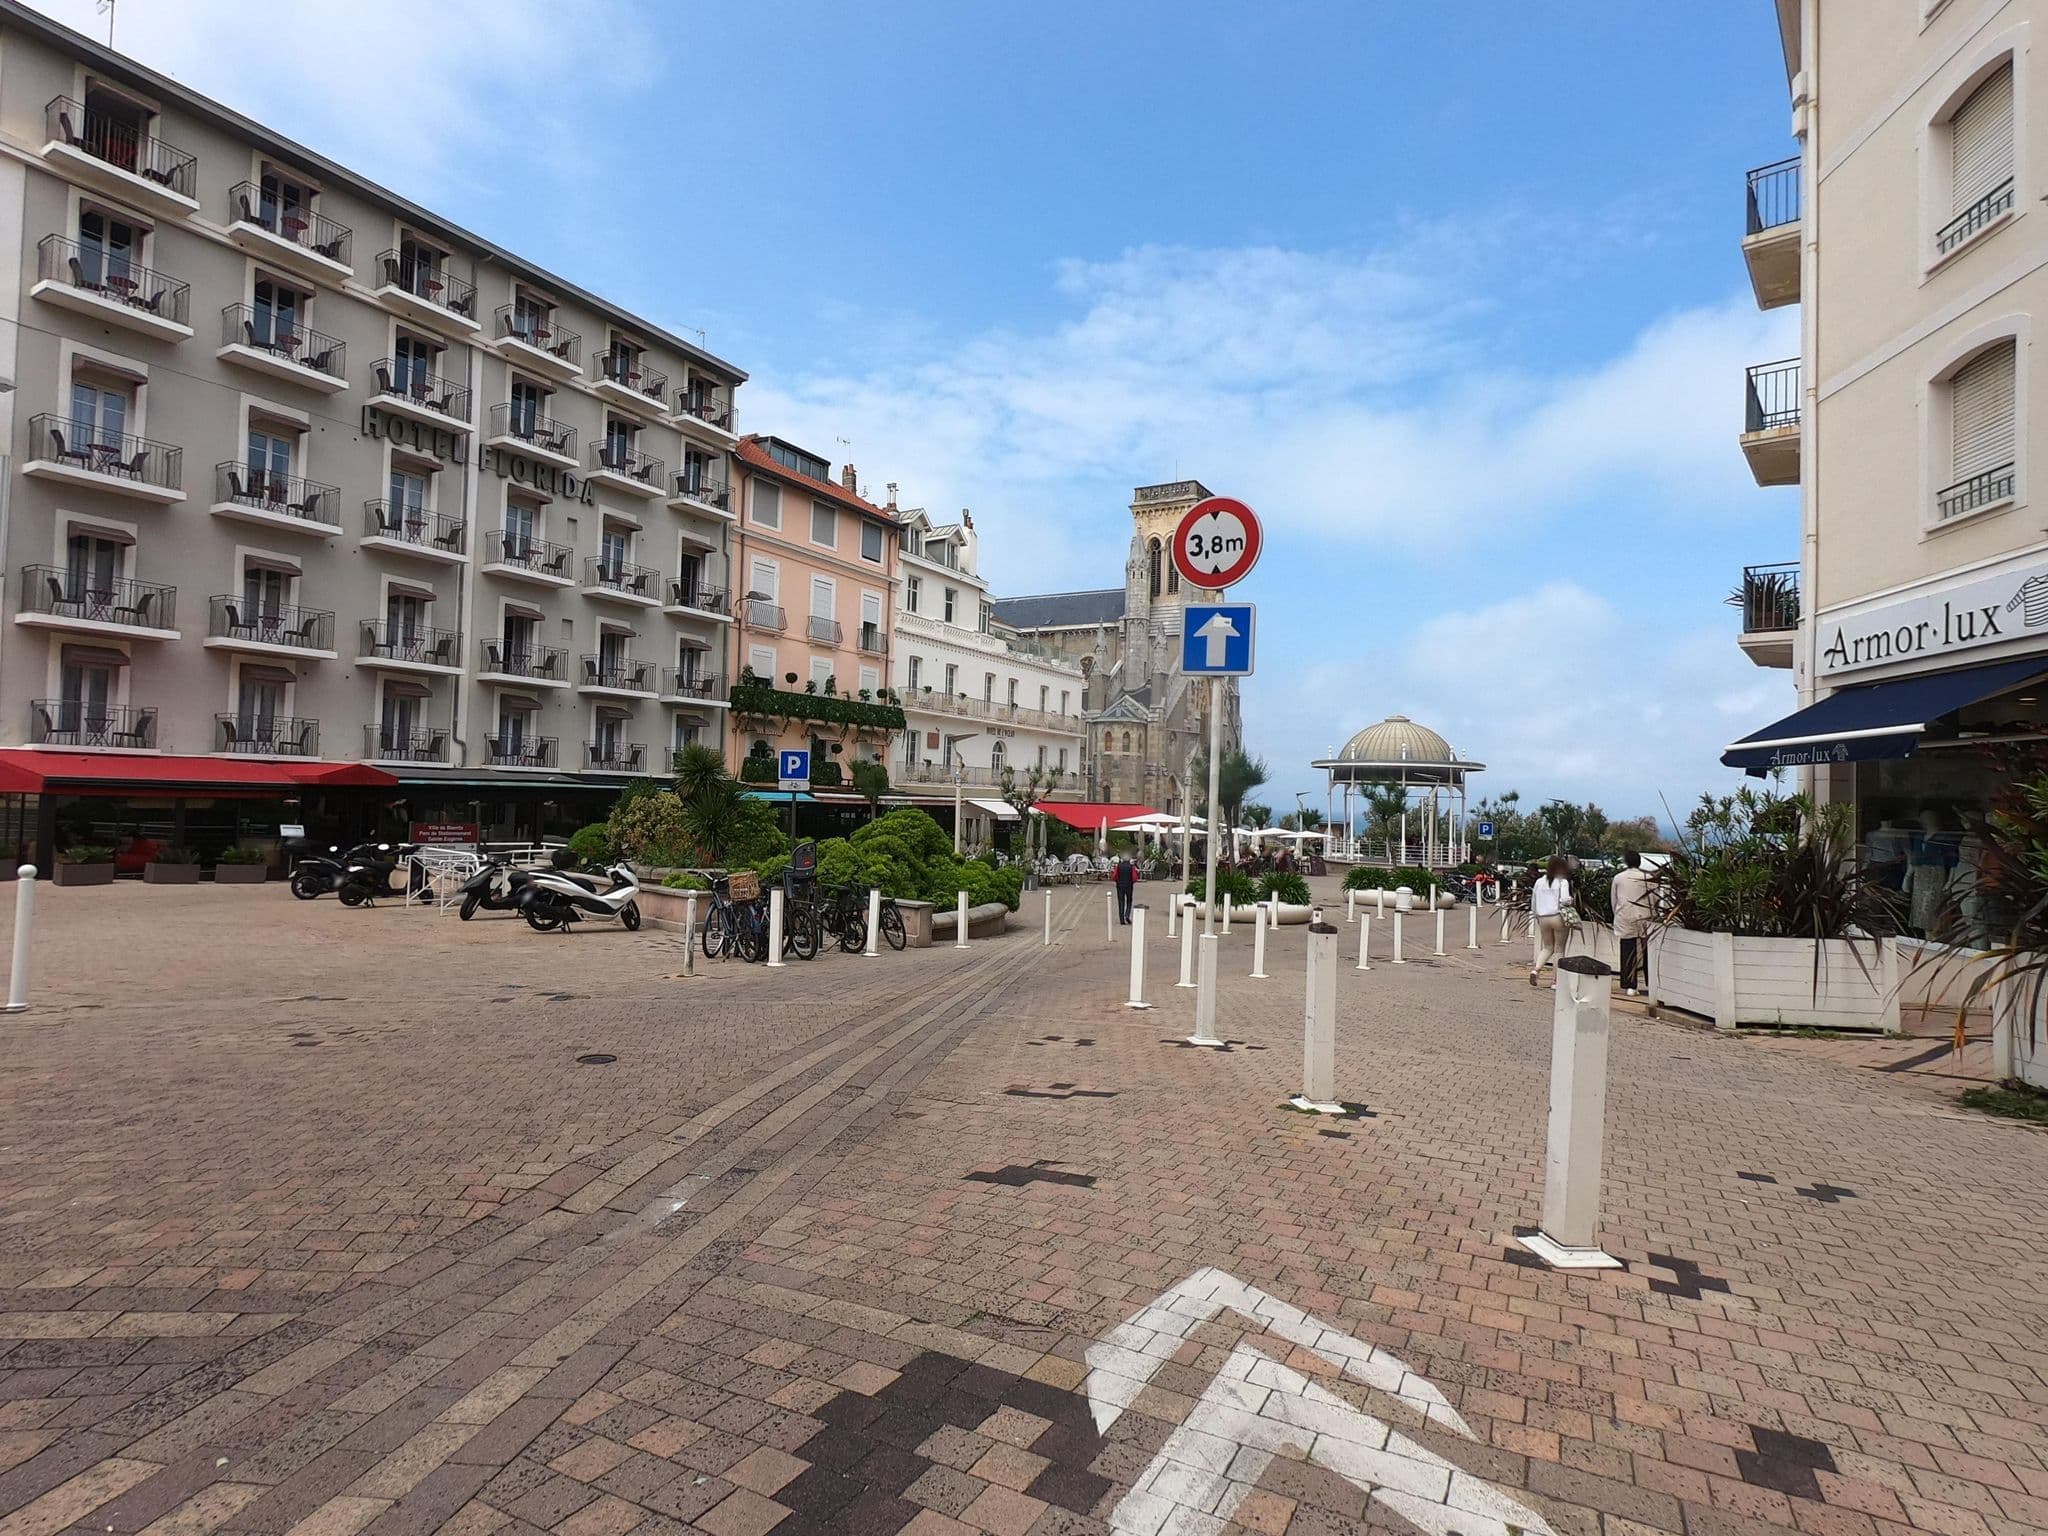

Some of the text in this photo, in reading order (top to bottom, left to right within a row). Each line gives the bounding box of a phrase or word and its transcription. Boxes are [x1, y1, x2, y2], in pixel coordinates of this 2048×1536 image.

[362, 405, 597, 506] HOTEL FLORIDA
[1188, 534, 1244, 560] 3,8m
[787, 755, 801, 775] P
